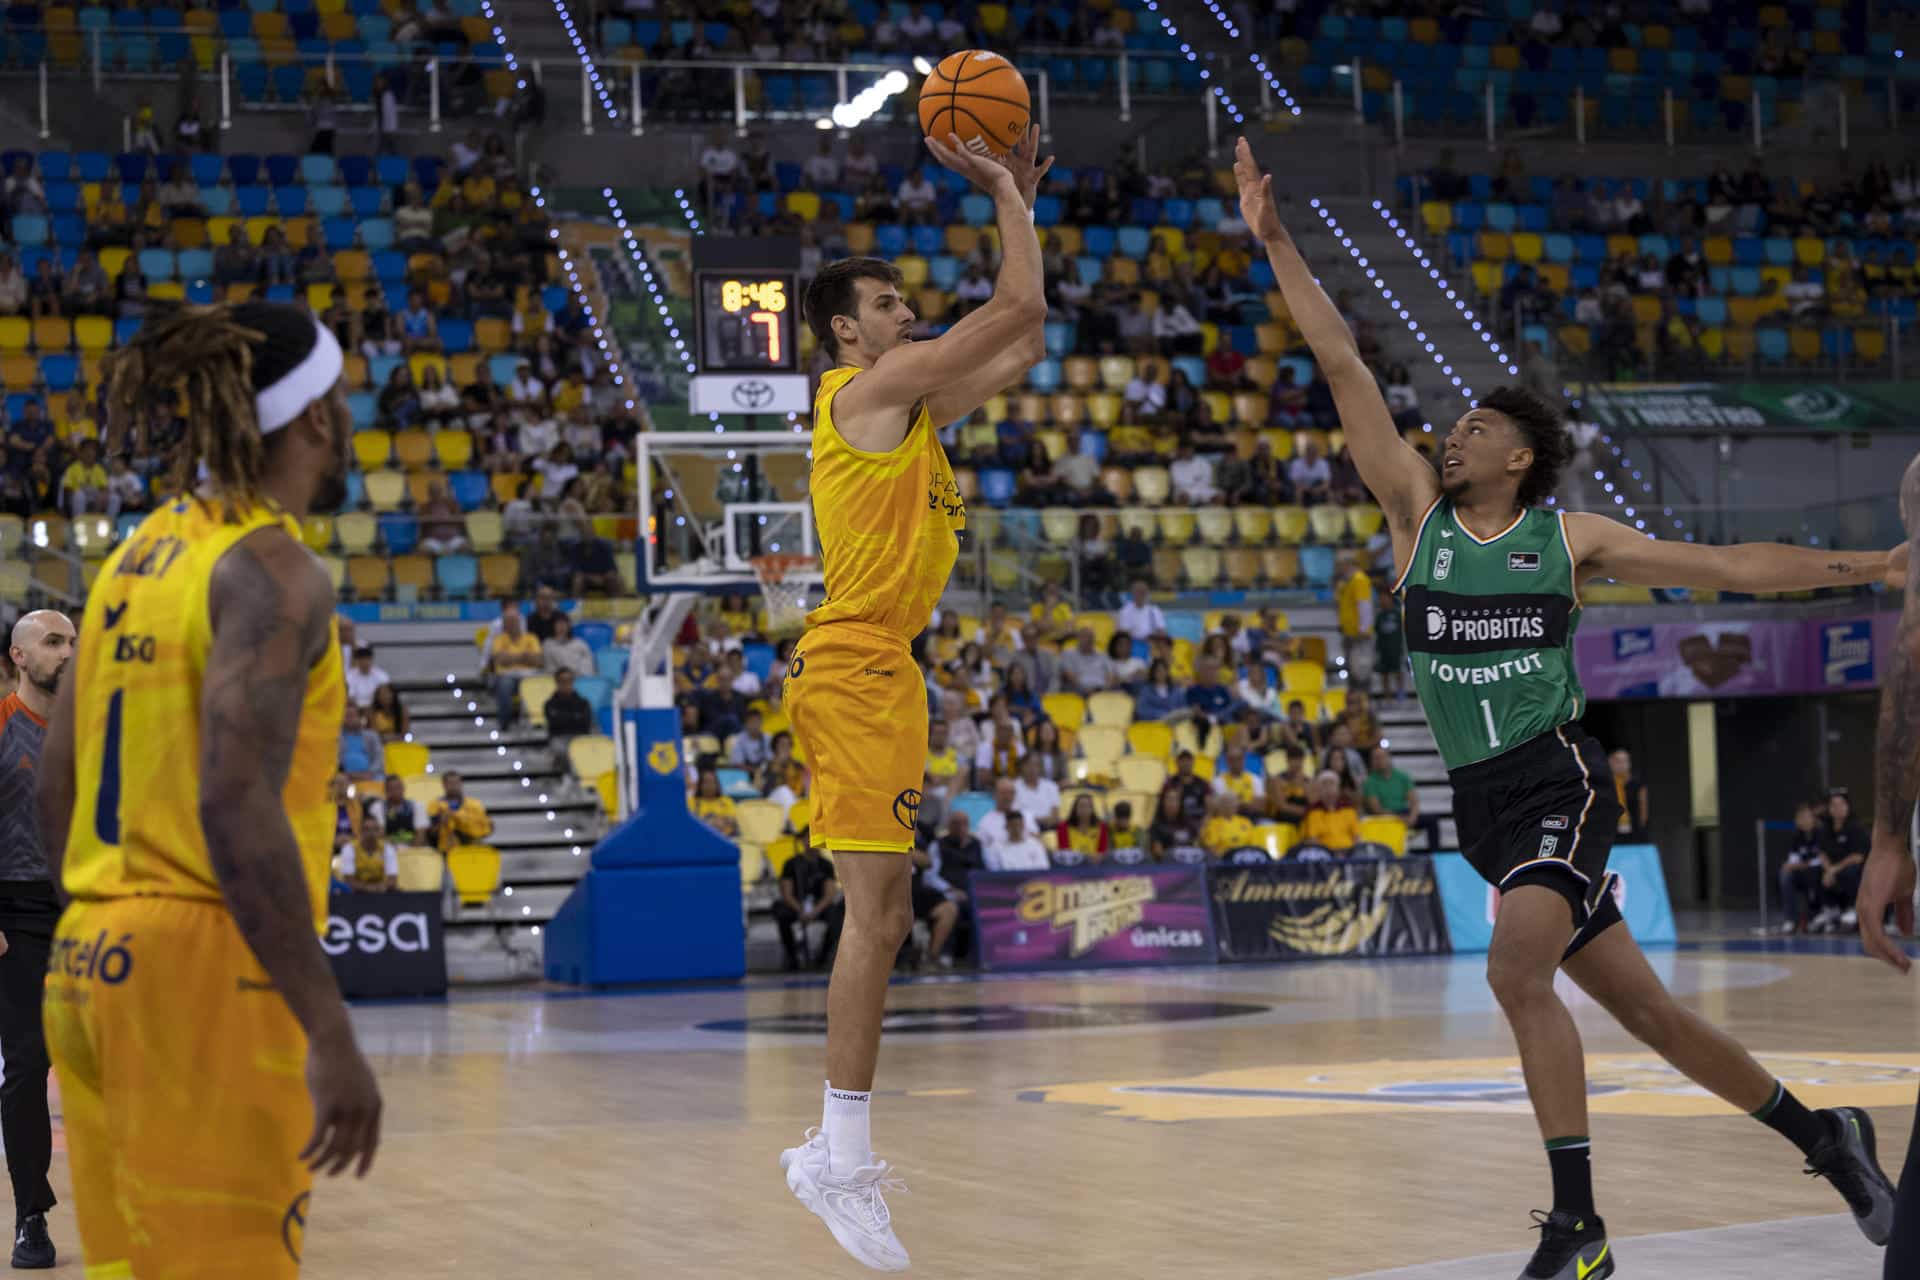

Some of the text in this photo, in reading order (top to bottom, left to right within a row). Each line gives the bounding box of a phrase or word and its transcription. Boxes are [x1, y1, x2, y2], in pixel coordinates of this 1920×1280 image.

[722, 280, 786, 312] 8:46
[750, 311, 780, 362] 7
[1452, 616, 1545, 641] PROBITAS
[1480, 699, 1501, 748] 1
